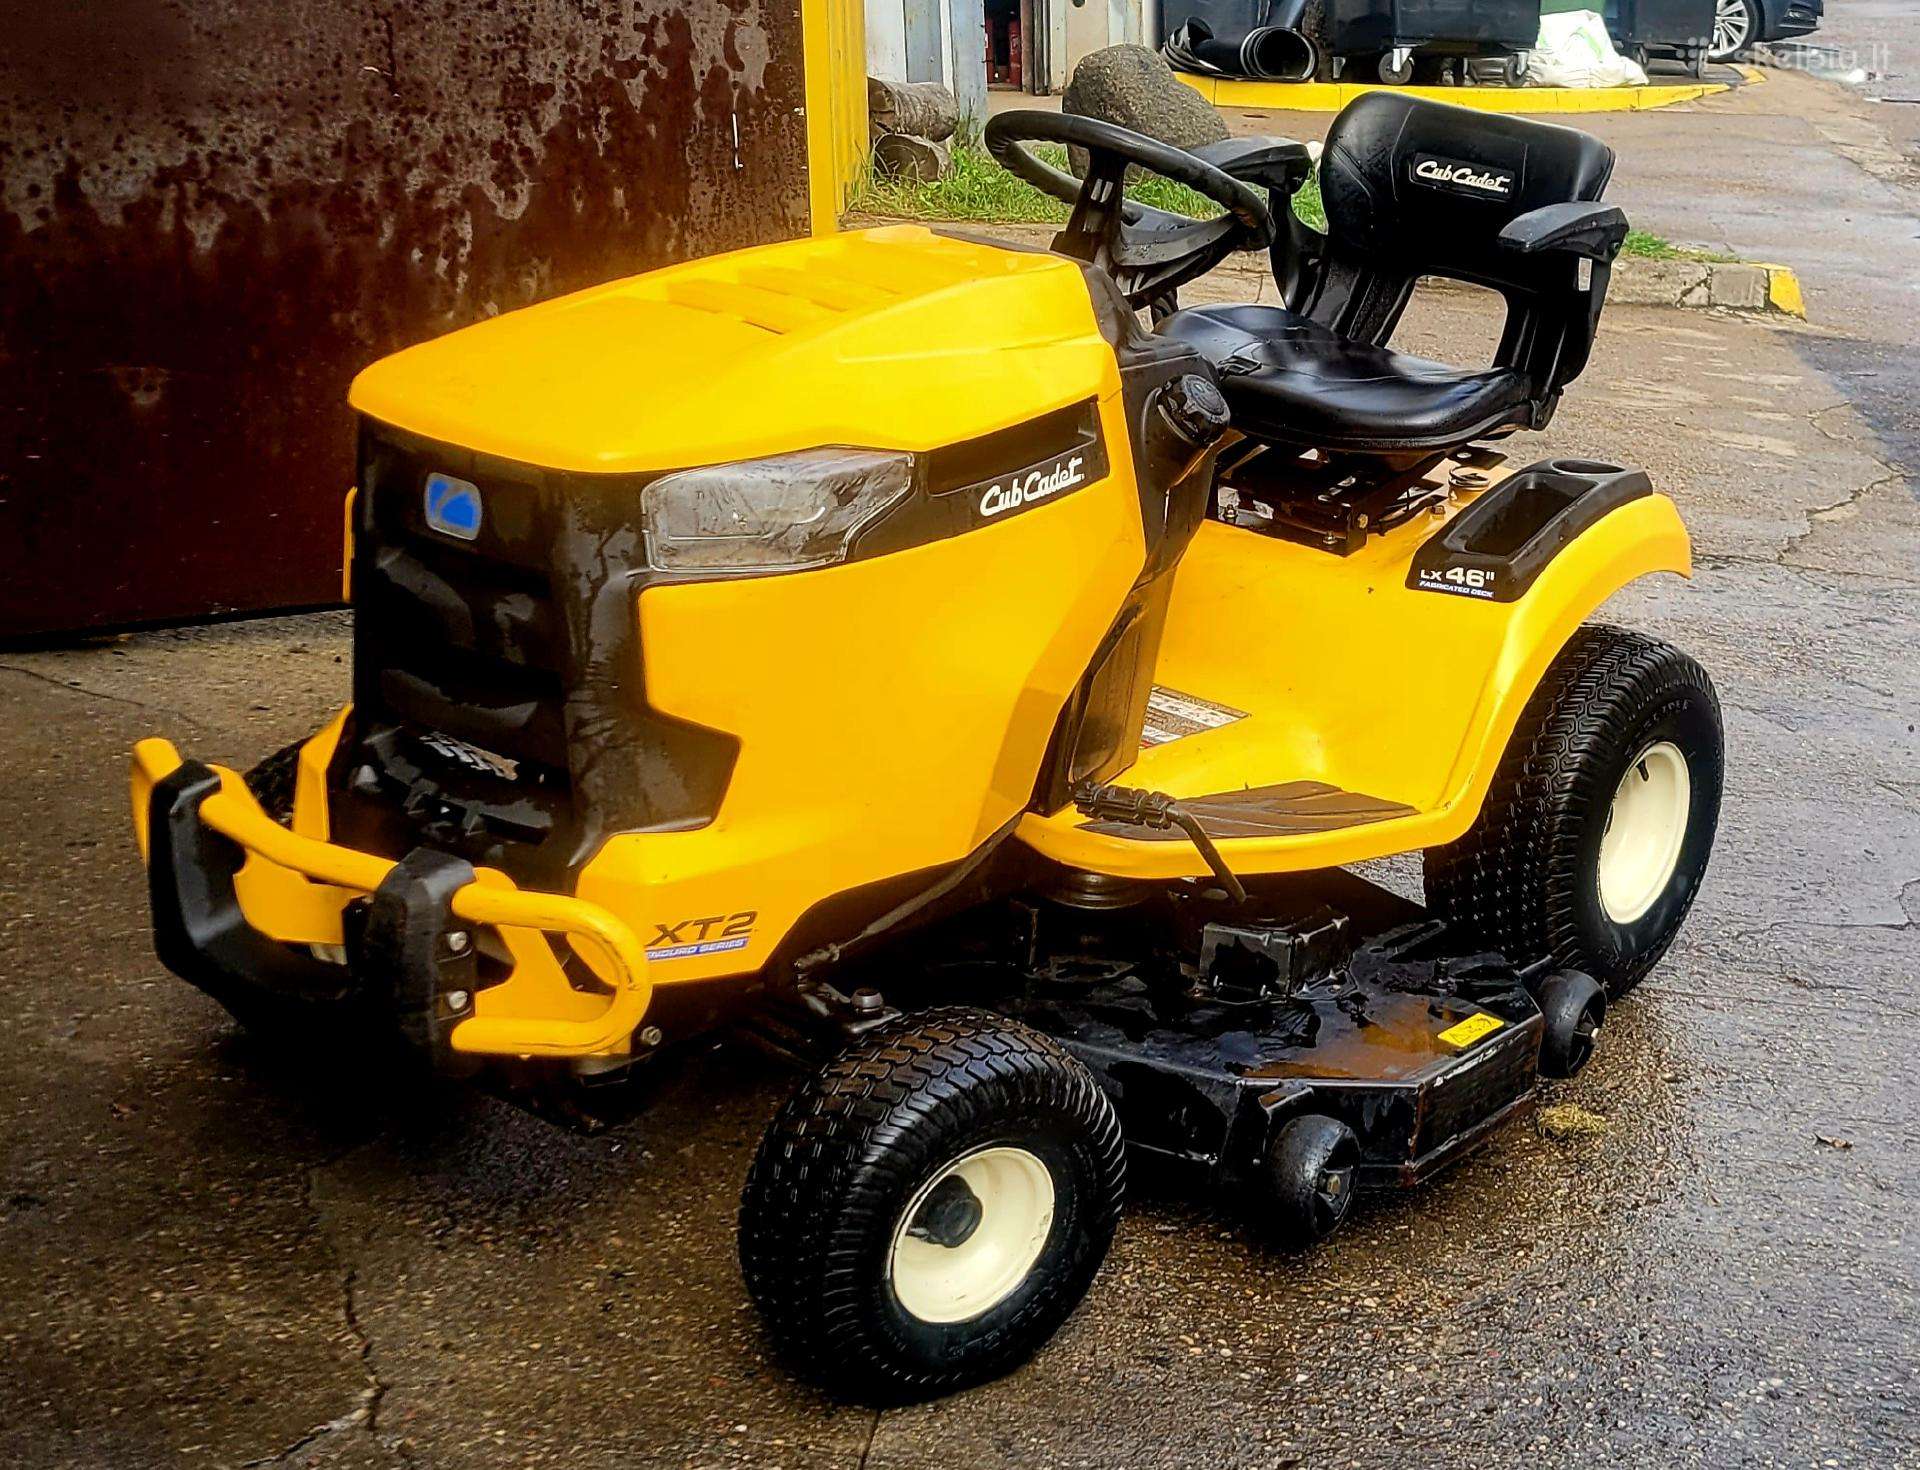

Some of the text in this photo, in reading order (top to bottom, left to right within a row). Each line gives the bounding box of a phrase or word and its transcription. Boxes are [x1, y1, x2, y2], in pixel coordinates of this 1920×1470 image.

[1416, 160, 1511, 193] Cub Cadet
[980, 457, 1084, 516] Cub Cadet
[1419, 580, 1494, 598] FABRICATED DECK
[1420, 566, 1495, 588] LX 46"
[644, 911, 758, 947] XT2
[699, 938, 747, 952] SERIES
